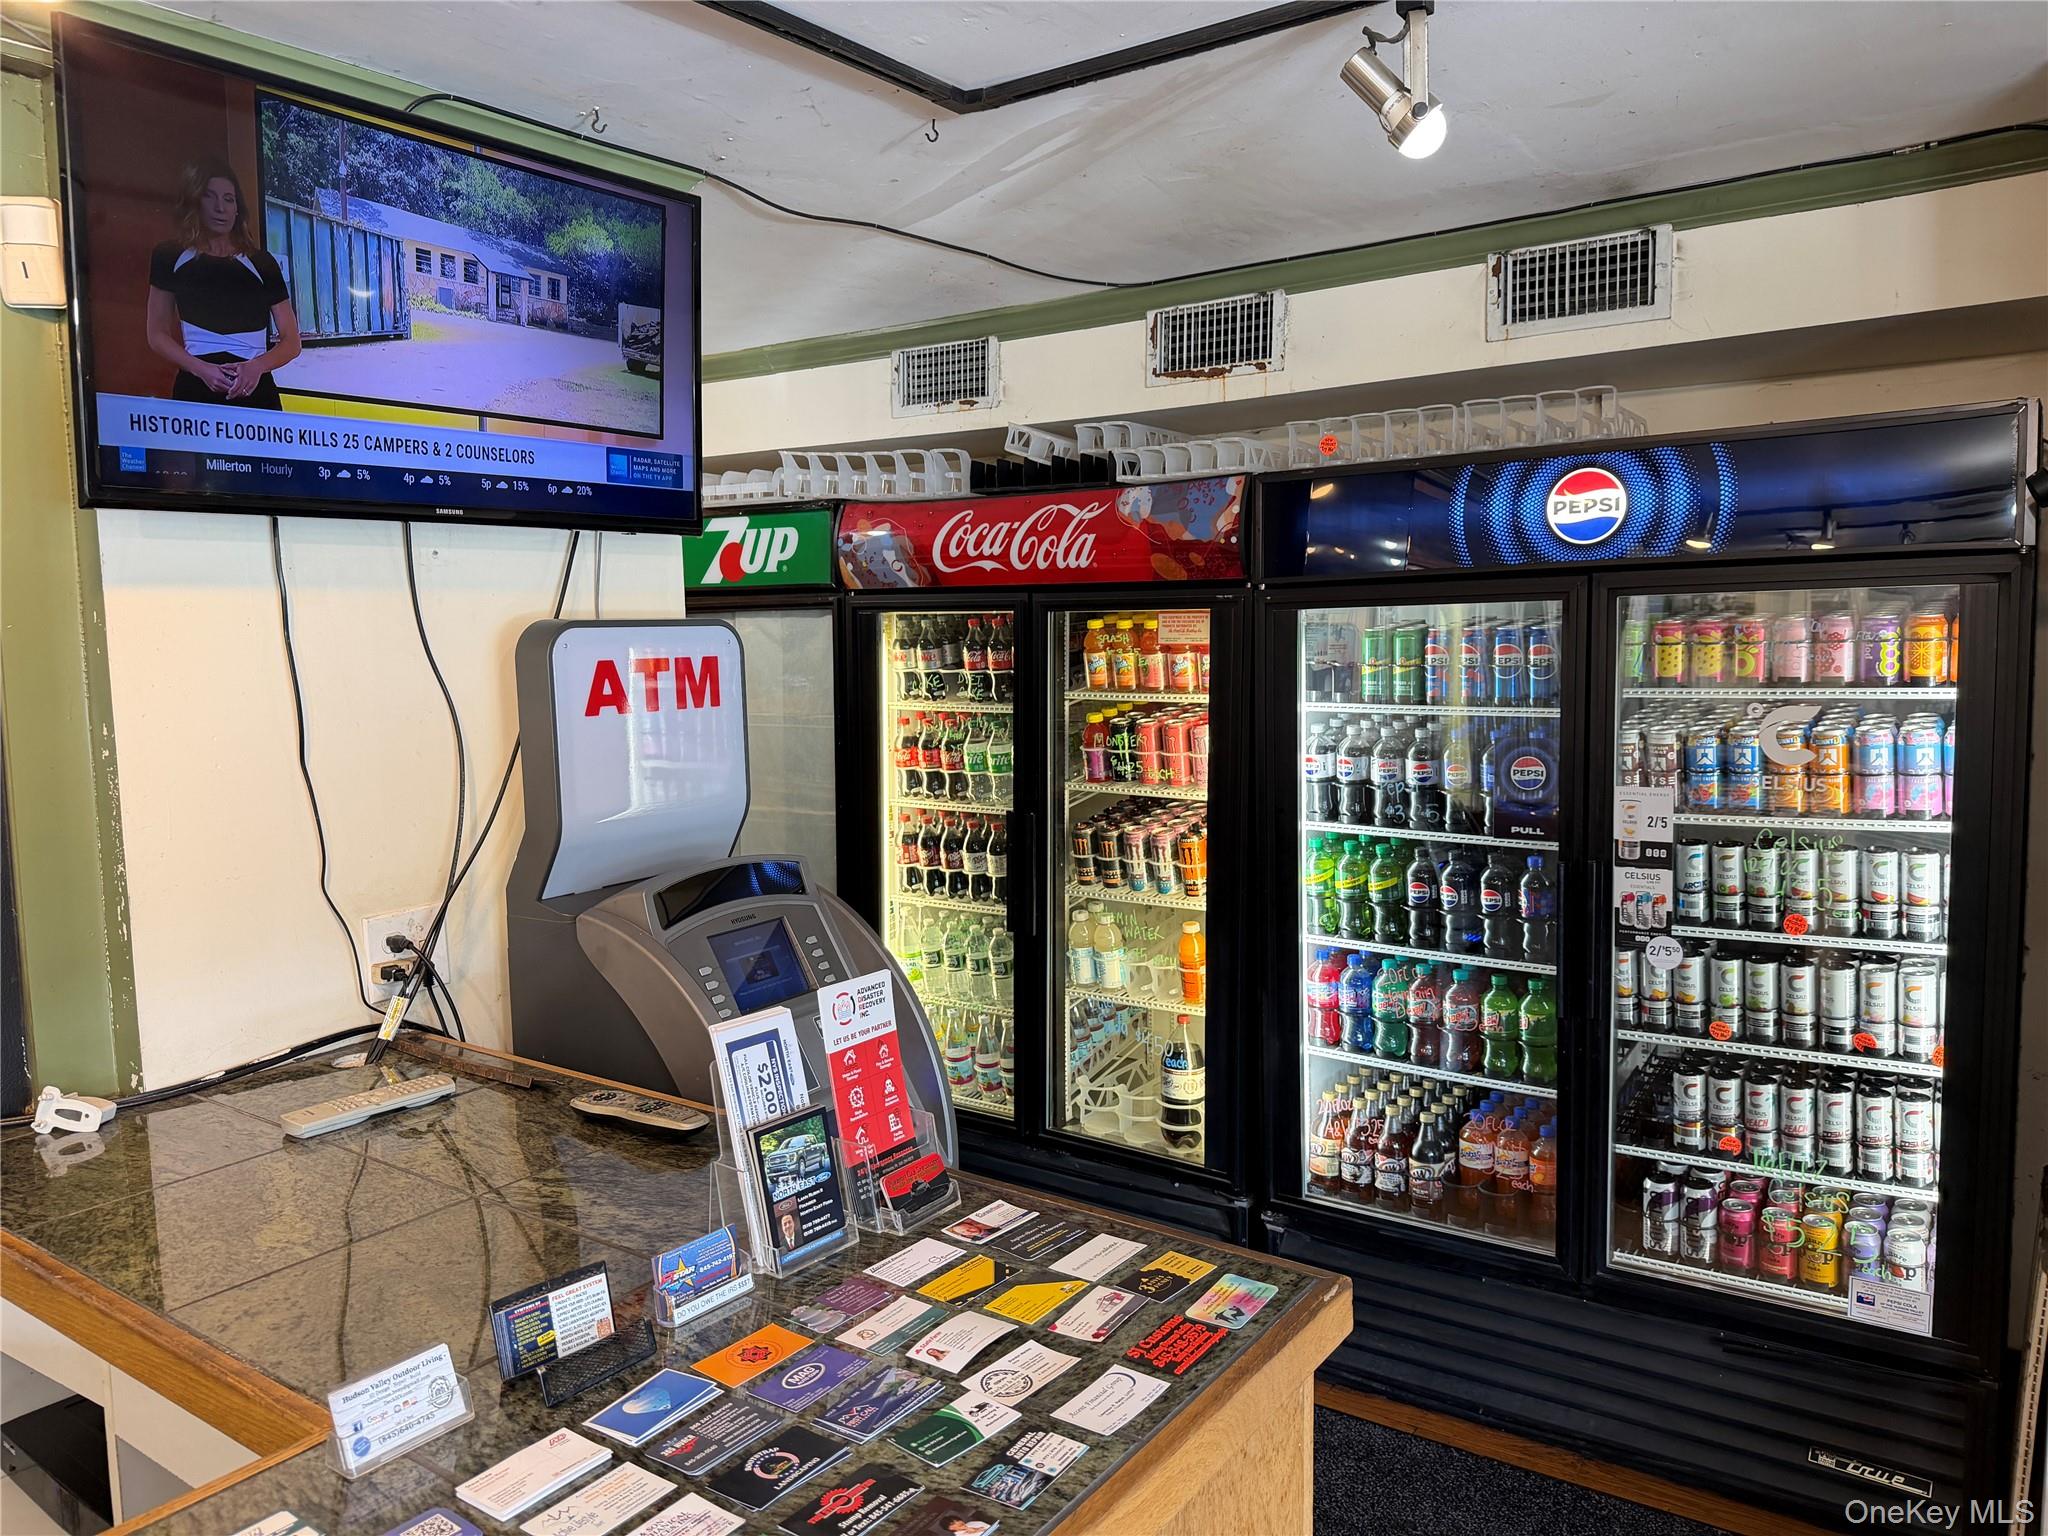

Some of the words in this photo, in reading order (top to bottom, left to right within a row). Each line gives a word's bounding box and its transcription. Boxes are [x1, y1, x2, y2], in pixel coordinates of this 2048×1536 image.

[129, 413, 210, 437] HISTORIC
[216, 421, 294, 445] FLOODING
[298, 429, 338, 448] KILLS
[342, 433, 360, 450] 25
[364, 435, 429, 456] CAMPERS
[432, 442, 441, 456] &
[444, 443, 452, 457] 2
[456, 445, 535, 465] COUNSELORS
[633, 464, 649, 472] MAPS
[654, 458, 680, 467] SATELLITE
[206, 459, 252, 473] Millerton
[261, 462, 293, 478] Hourly
[318, 467, 331, 480] 3p
[356, 469, 371, 481] 5%
[403, 472, 415, 486] 4p
[438, 474, 452, 486] 5%
[481, 478, 492, 490] 5p
[512, 480, 529, 492] 15%
[547, 484, 558, 496] 6p
[576, 485, 593, 497] 20%
[435, 507, 464, 515] SAMSUNG
[1553, 495, 1621, 517] PEPSI
[932, 501, 1113, 572] Coca-Cola
[701, 516, 799, 585] 7UP
[584, 655, 721, 717] ATM
[1378, 766, 1398, 774] PEPSI
[1412, 767, 1433, 776] PEPSI
[1512, 768, 1545, 779] PEPSI
[1510, 825, 1545, 836] PULL
[1624, 871, 1661, 881] CELSIUS
[1124, 925, 1165, 941] WATER
[856, 981, 886, 995] ADVANCED
[857, 989, 884, 1003] DISASTER
[858, 996, 886, 1011] RECOVERY
[833, 1037, 842, 1046] LET
[842, 1034, 850, 1043] US
[850, 1032, 857, 1040] BE
[858, 1027, 871, 1037] YOUR
[871, 1019, 893, 1032] PARTNER
[1165, 1053, 1189, 1070] each
[757, 1062, 778, 1115] $2.00
[773, 1072, 788, 1115] INSPECTION
[1325, 1119, 1350, 1139] A&W
[1746, 1119, 1769, 1127] PEACH
[1784, 1124, 1808, 1133] PEACH
[772, 1185, 797, 1201] NORTH
[799, 1176, 816, 1189] EAST
[1511, 1179, 1534, 1193] each
[551, 1293, 566, 1301] FEEL
[565, 1286, 582, 1296] GREAT
[582, 1278, 603, 1290] SYSTEM
[676, 1309, 687, 1319] DO
[687, 1302, 700, 1313] YOU
[700, 1295, 714, 1307] OWE
[715, 1290, 726, 1299] THE
[727, 1284, 737, 1293] IRS
[1887, 1298, 1902, 1306] PEPSI
[1903, 1302, 1918, 1310] COLA
[341, 1388, 370, 1404] Hudson
[370, 1377, 392, 1392] Valley
[392, 1364, 421, 1380] Outdoor
[421, 1353, 443, 1368] Living
[787, 1366, 815, 1384] MAG
[1005, 1431, 1037, 1457] GENERAL
[1013, 1446, 1029, 1460] AUTO
[1027, 1431, 1047, 1448] REPAIR
[744, 1446, 780, 1472] BOOTSTRAP
[773, 1456, 821, 1491] LANDSCAPING
[838, 1509, 863, 1529] Stump
[861, 1493, 888, 1517] Removal
